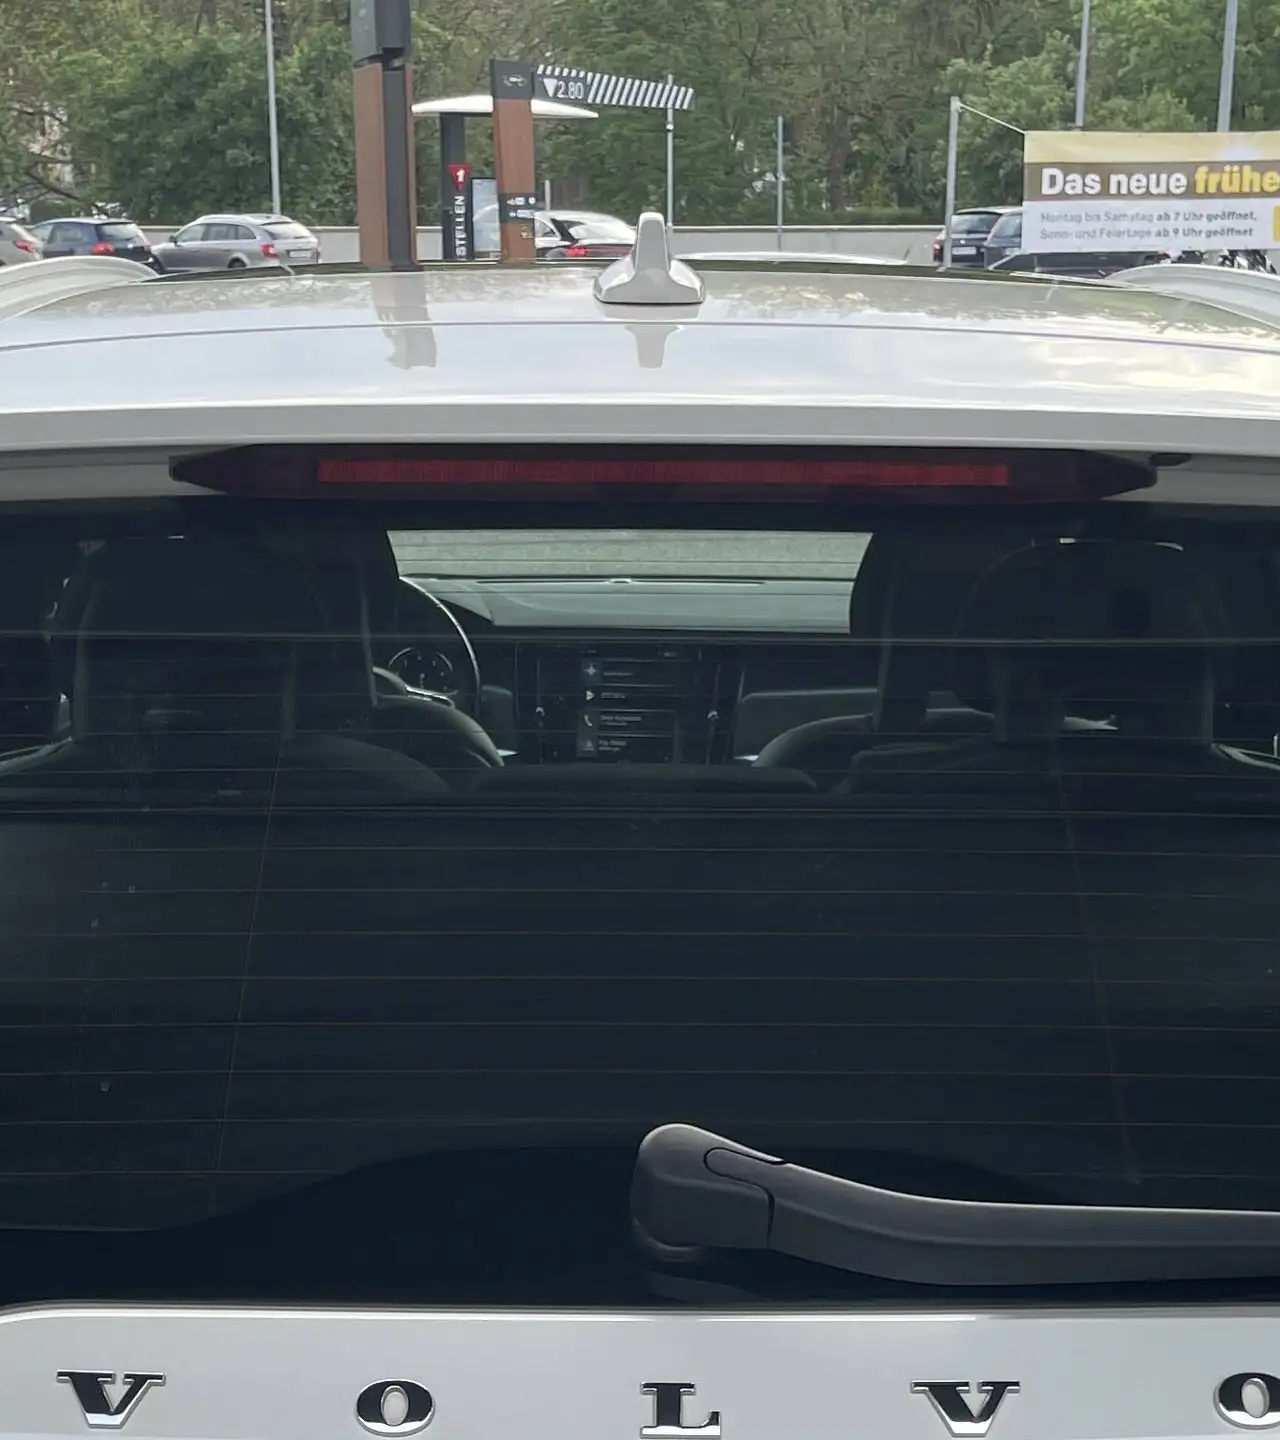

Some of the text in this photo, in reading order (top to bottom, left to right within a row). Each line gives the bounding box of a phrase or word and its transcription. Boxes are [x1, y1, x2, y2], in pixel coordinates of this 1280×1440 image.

[556, 80, 584, 99] 2.80
[456, 168, 465, 182] 1
[1041, 167, 1102, 195] Das
[1109, 171, 1188, 195] neue
[1195, 164, 1280, 193] frühe
[1040, 212, 1082, 224] Montag
[1103, 211, 1154, 224] Samstag
[1156, 211, 1170, 221] ab
[1183, 211, 1204, 221] Uhr
[454, 195, 467, 260] STELLEN
[1099, 228, 1152, 239] Feiertage
[1154, 227, 1170, 237] ab
[1182, 227, 1204, 237] Uhr
[1205, 226, 1254, 238] geöffnet
